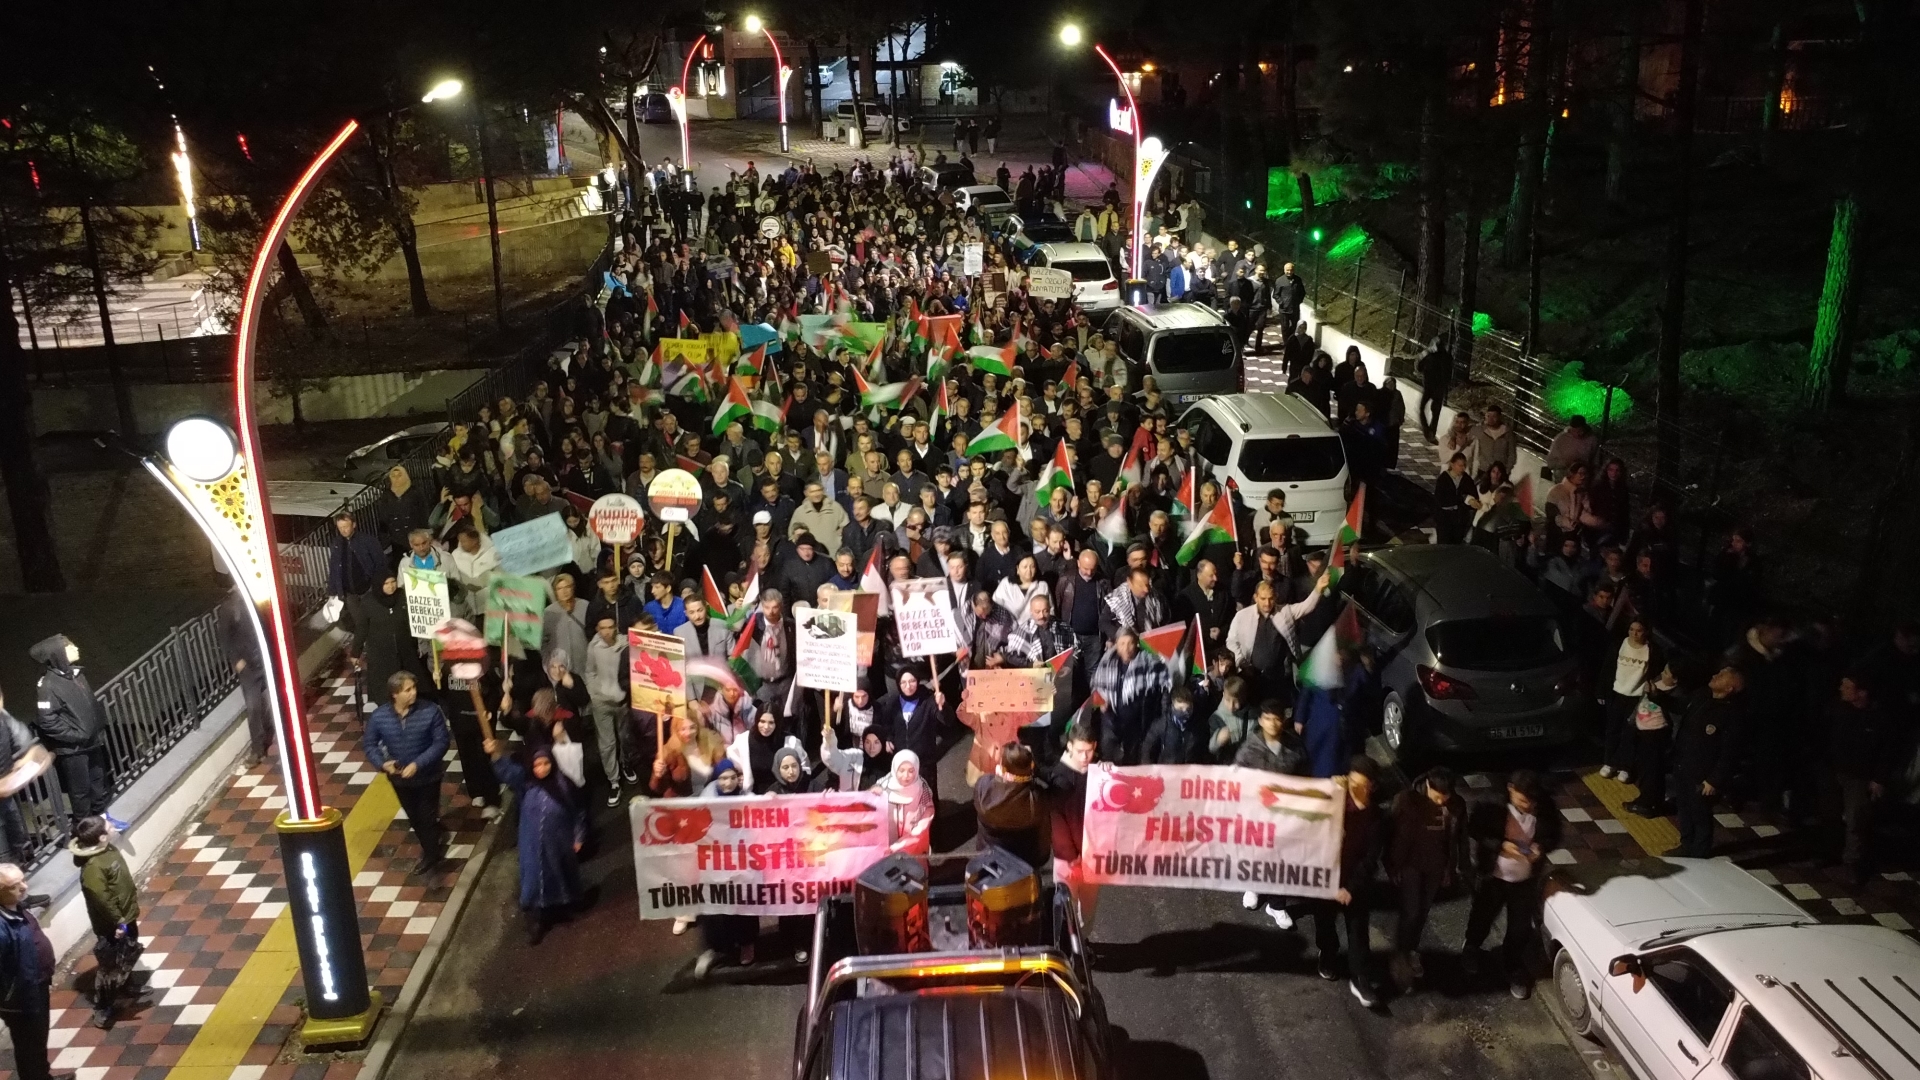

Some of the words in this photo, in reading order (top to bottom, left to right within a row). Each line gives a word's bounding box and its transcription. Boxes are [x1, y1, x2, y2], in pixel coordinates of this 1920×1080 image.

[594, 506, 638, 519] KUDÜS
[1300, 512, 1312, 520] 775
[408, 595, 442, 607] GAZZE'DE
[410, 606, 444, 617] BEBEKLER
[901, 619, 945, 631] BEBEKLER
[1180, 775, 1241, 802] DİREN
[729, 805, 789, 828] DİREN
[1145, 811, 1276, 848] FİLİSTİN!
[1093, 850, 1147, 875] TÜRK
[1153, 852, 1231, 880] MİLLETİ
[1237, 858, 1332, 888] SENİNLE!
[648, 882, 704, 909] TÜRK
[710, 878, 786, 906] MİLLETİ
[792, 877, 853, 905] SENİN
